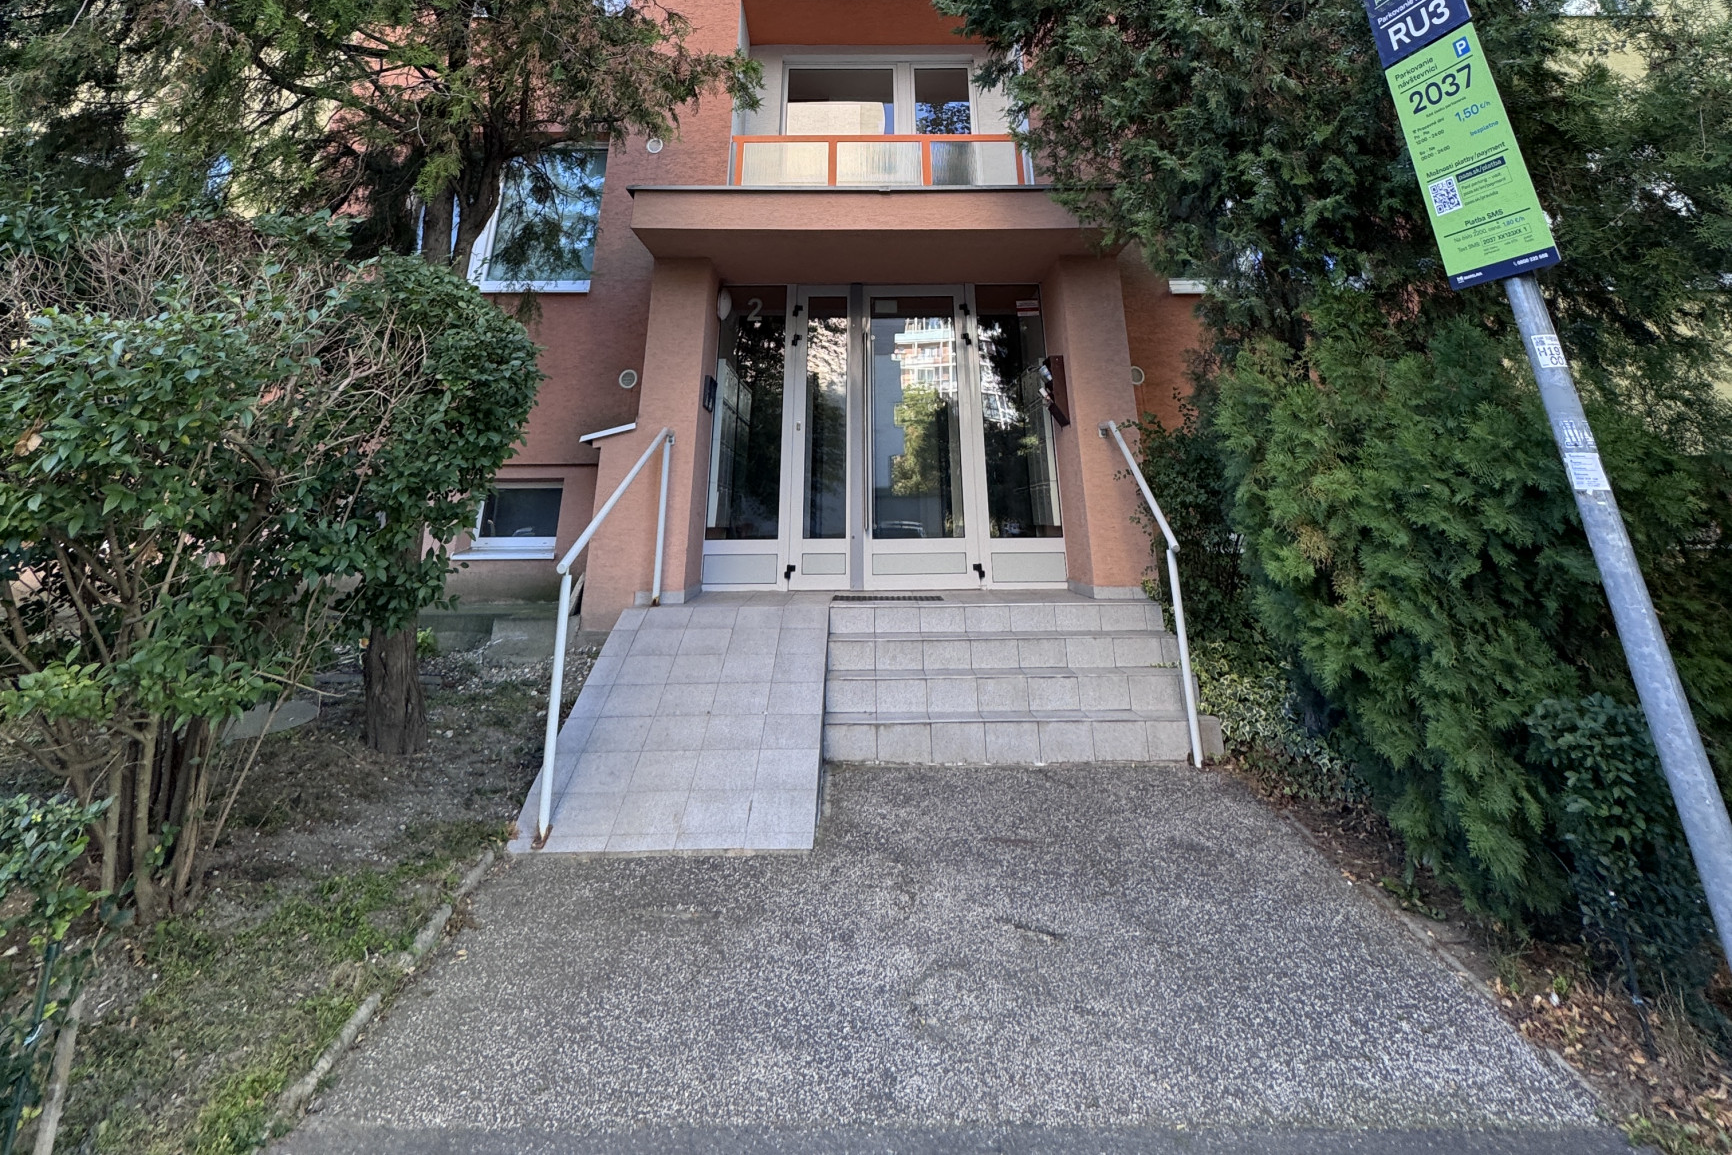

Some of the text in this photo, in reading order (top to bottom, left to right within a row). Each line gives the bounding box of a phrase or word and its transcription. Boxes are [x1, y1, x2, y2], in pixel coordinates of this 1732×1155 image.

[1394, 57, 1434, 82] Parkovanie
[1397, 63, 1438, 90] návštevníci
[1409, 63, 1471, 115] 2037
[1454, 101, 1491, 122] 1,50 €/h
[1426, 162, 1454, 178] Možnosti
[1458, 159, 1502, 181] paas.sk/platba
[1464, 208, 1504, 227] Platba SMS
[1482, 236, 1496, 245] 2037
[747, 298, 762, 321] 2
[1537, 346, 1562, 356] H19
